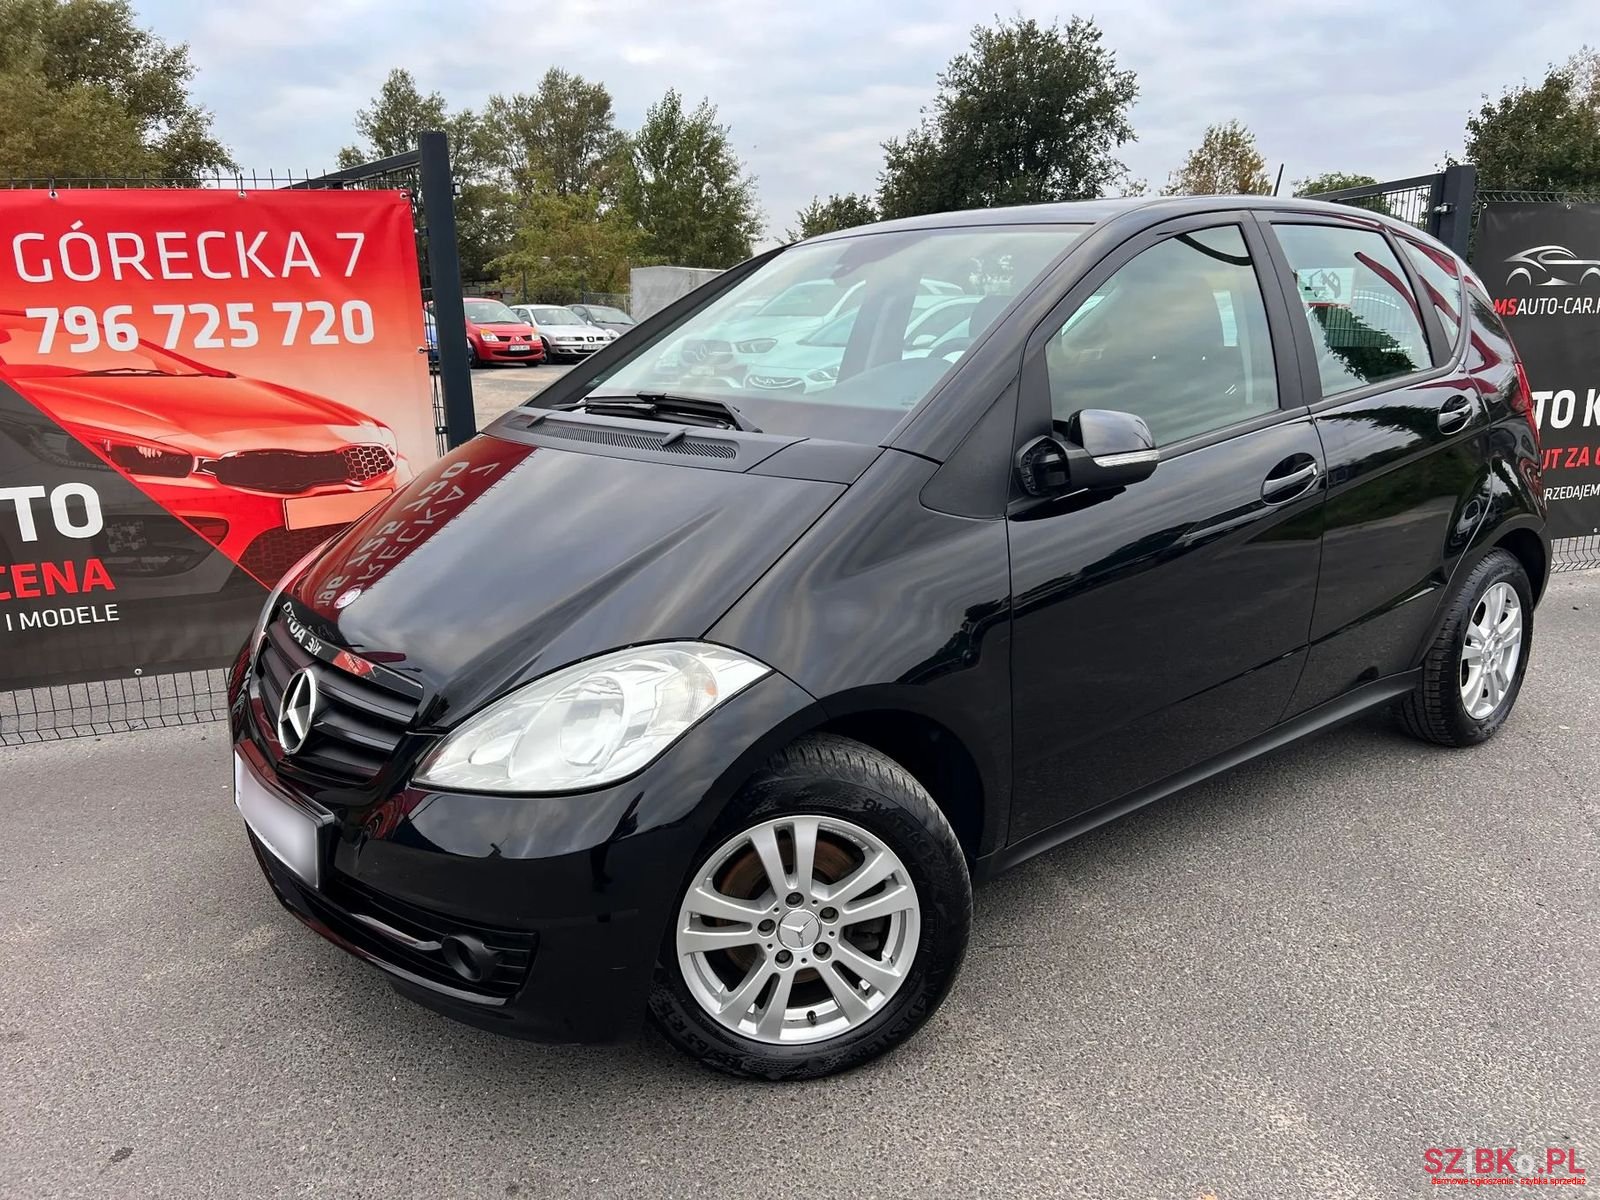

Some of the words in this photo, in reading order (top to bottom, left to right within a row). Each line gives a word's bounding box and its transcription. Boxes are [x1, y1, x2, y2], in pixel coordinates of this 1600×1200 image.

[13, 220, 321, 284] GÓRECKA
[335, 232, 366, 277] 7
[1494, 297, 1600, 316] MSAUTO-CAR.
[26, 305, 139, 354] 796
[153, 302, 258, 350] 725
[272, 300, 374, 346] 720
[1565, 446, 1590, 468] ZA
[1544, 483, 1600, 501] RZEDAJEM
[0, 482, 104, 542] TO
[5, 613, 13, 632] I
[19, 604, 120, 631] MODELE
